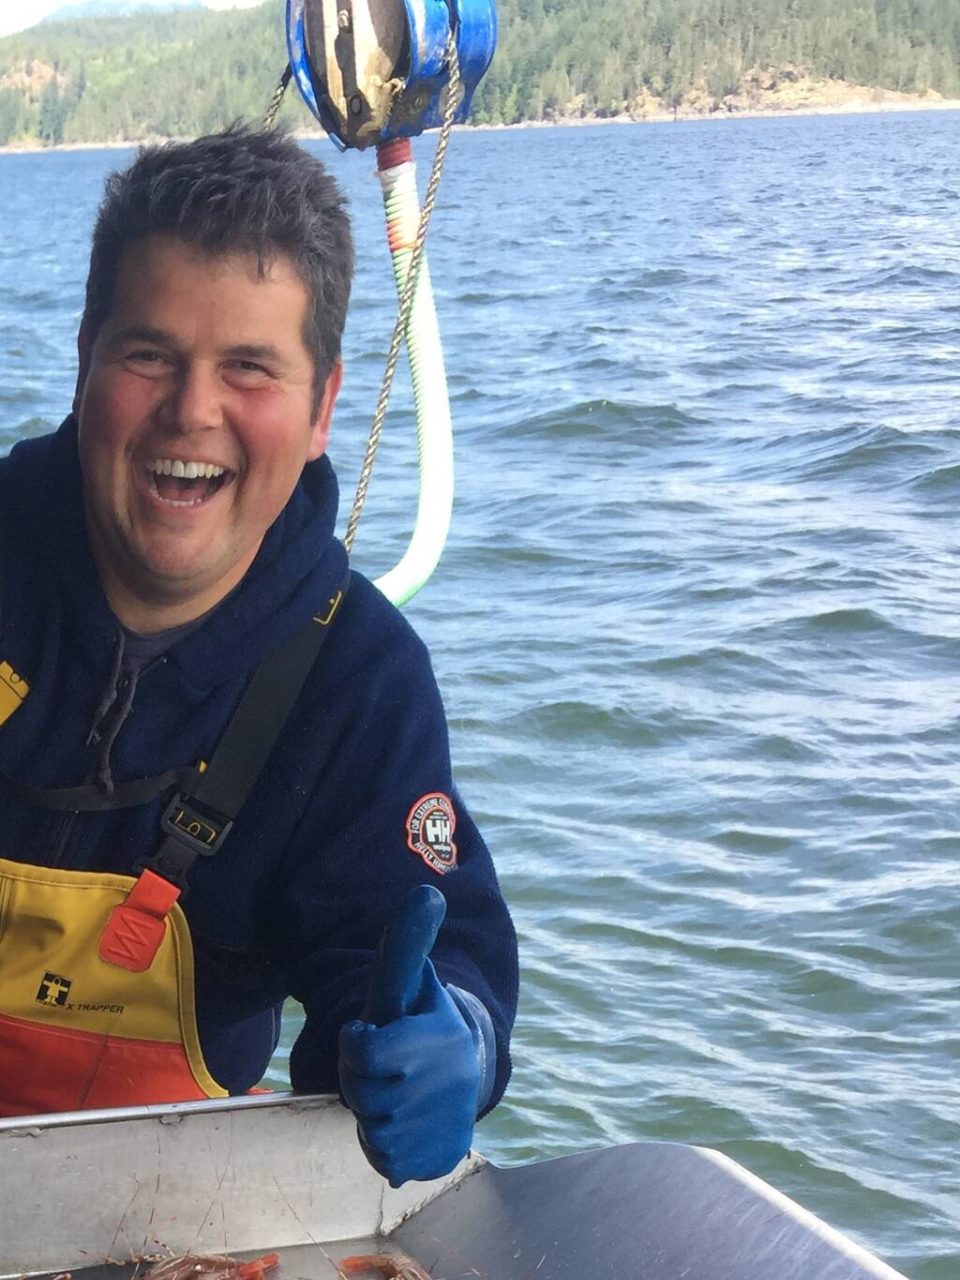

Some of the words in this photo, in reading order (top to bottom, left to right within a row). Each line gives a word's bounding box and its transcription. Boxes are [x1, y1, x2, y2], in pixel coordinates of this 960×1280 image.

[411, 817, 421, 834] FOR
[66, 1002, 74, 1012] X
[77, 1003, 125, 1015] TRAPPER
